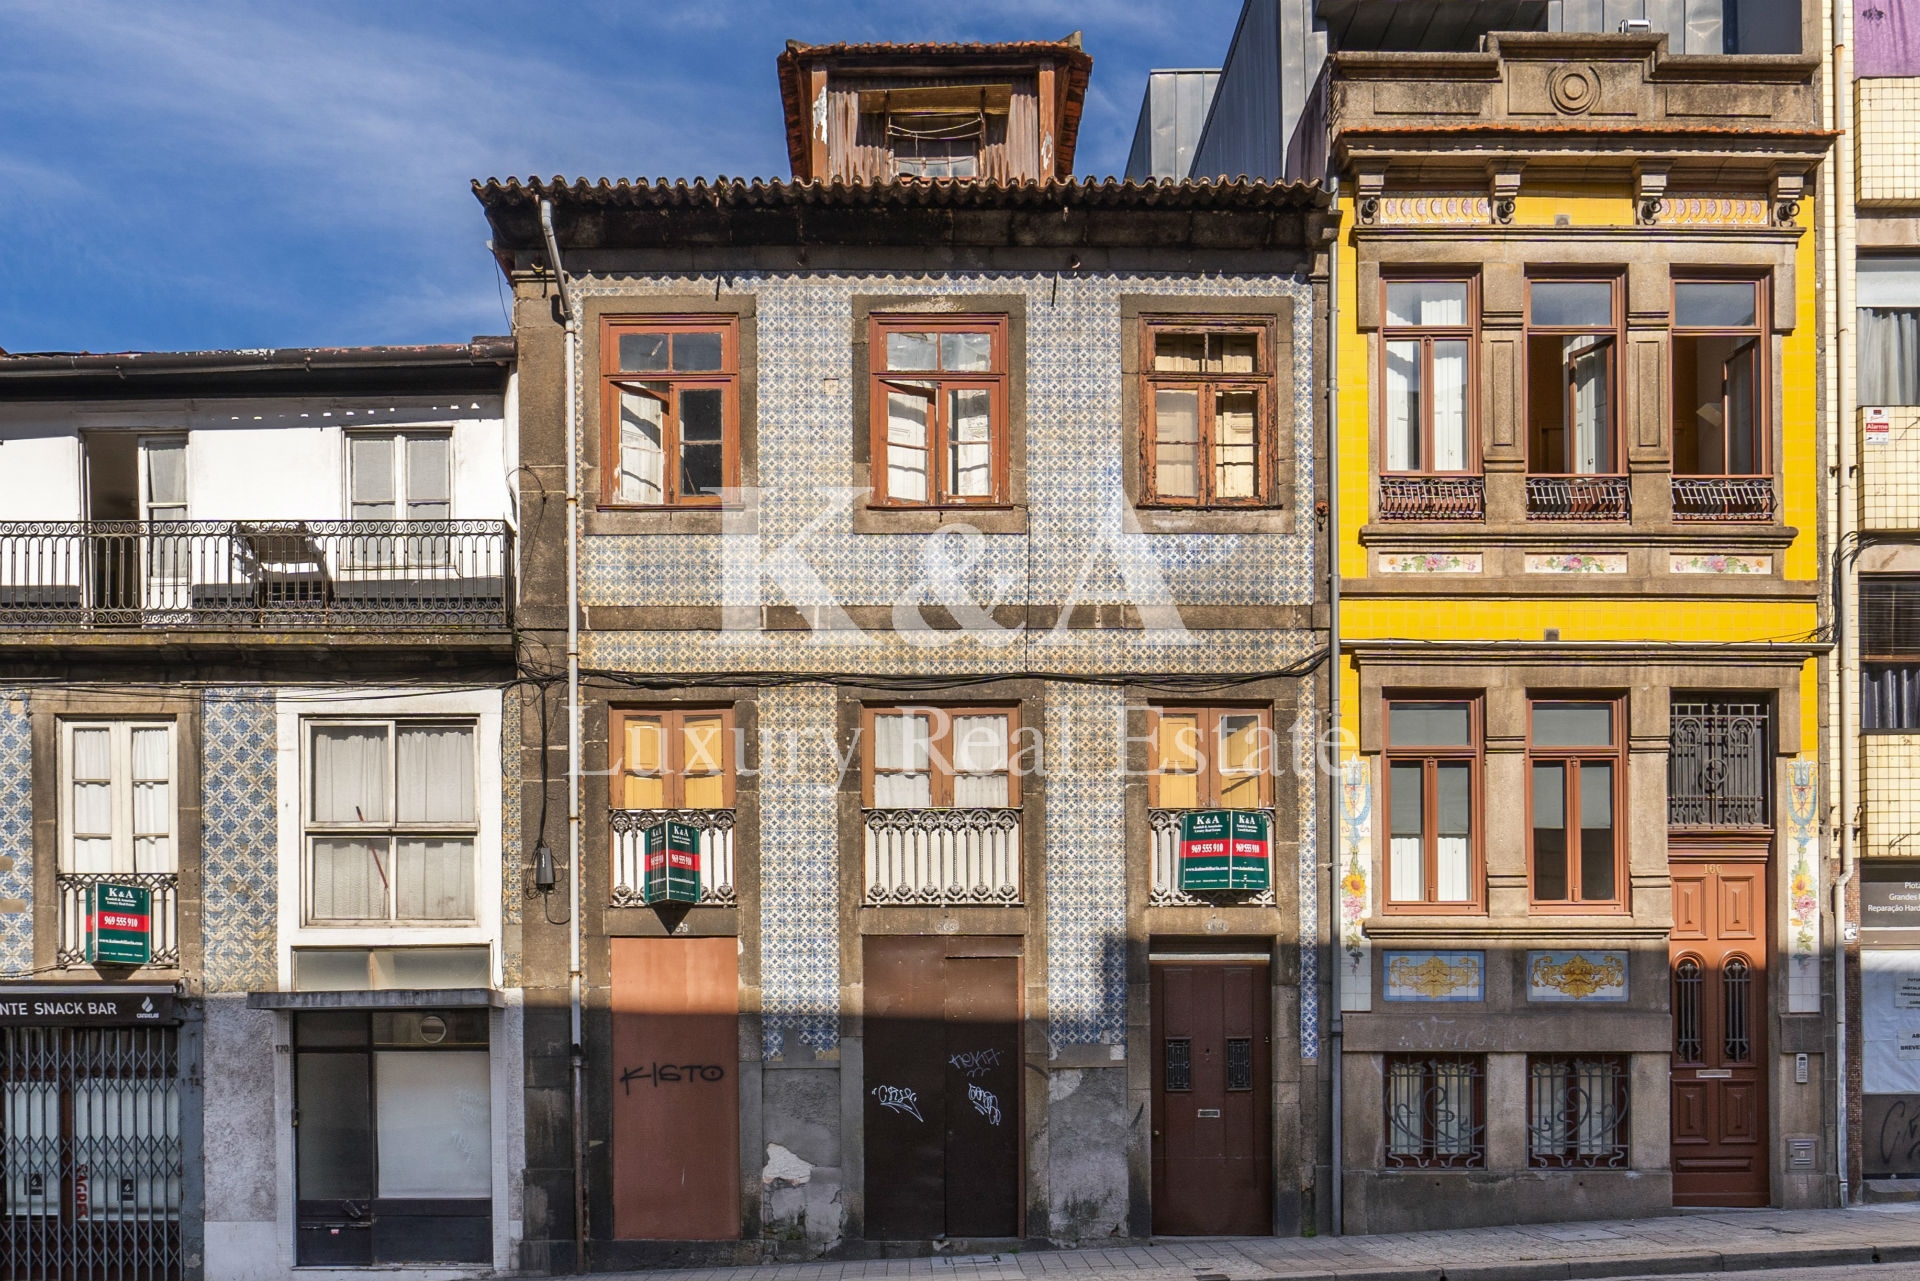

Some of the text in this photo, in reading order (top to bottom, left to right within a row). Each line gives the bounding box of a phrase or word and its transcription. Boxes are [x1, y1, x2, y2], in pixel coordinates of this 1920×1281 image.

[1191, 844, 1201, 853] 969
[1202, 844, 1211, 852] 555
[1888, 892, 1918, 901] Grandes
[1867, 904, 1904, 913] Reparação
[104, 915, 138, 928] 969 555 910
[34, 1002, 86, 1016] SNACK
[88, 1002, 118, 1016] BAR
[275, 1044, 289, 1053] 170
